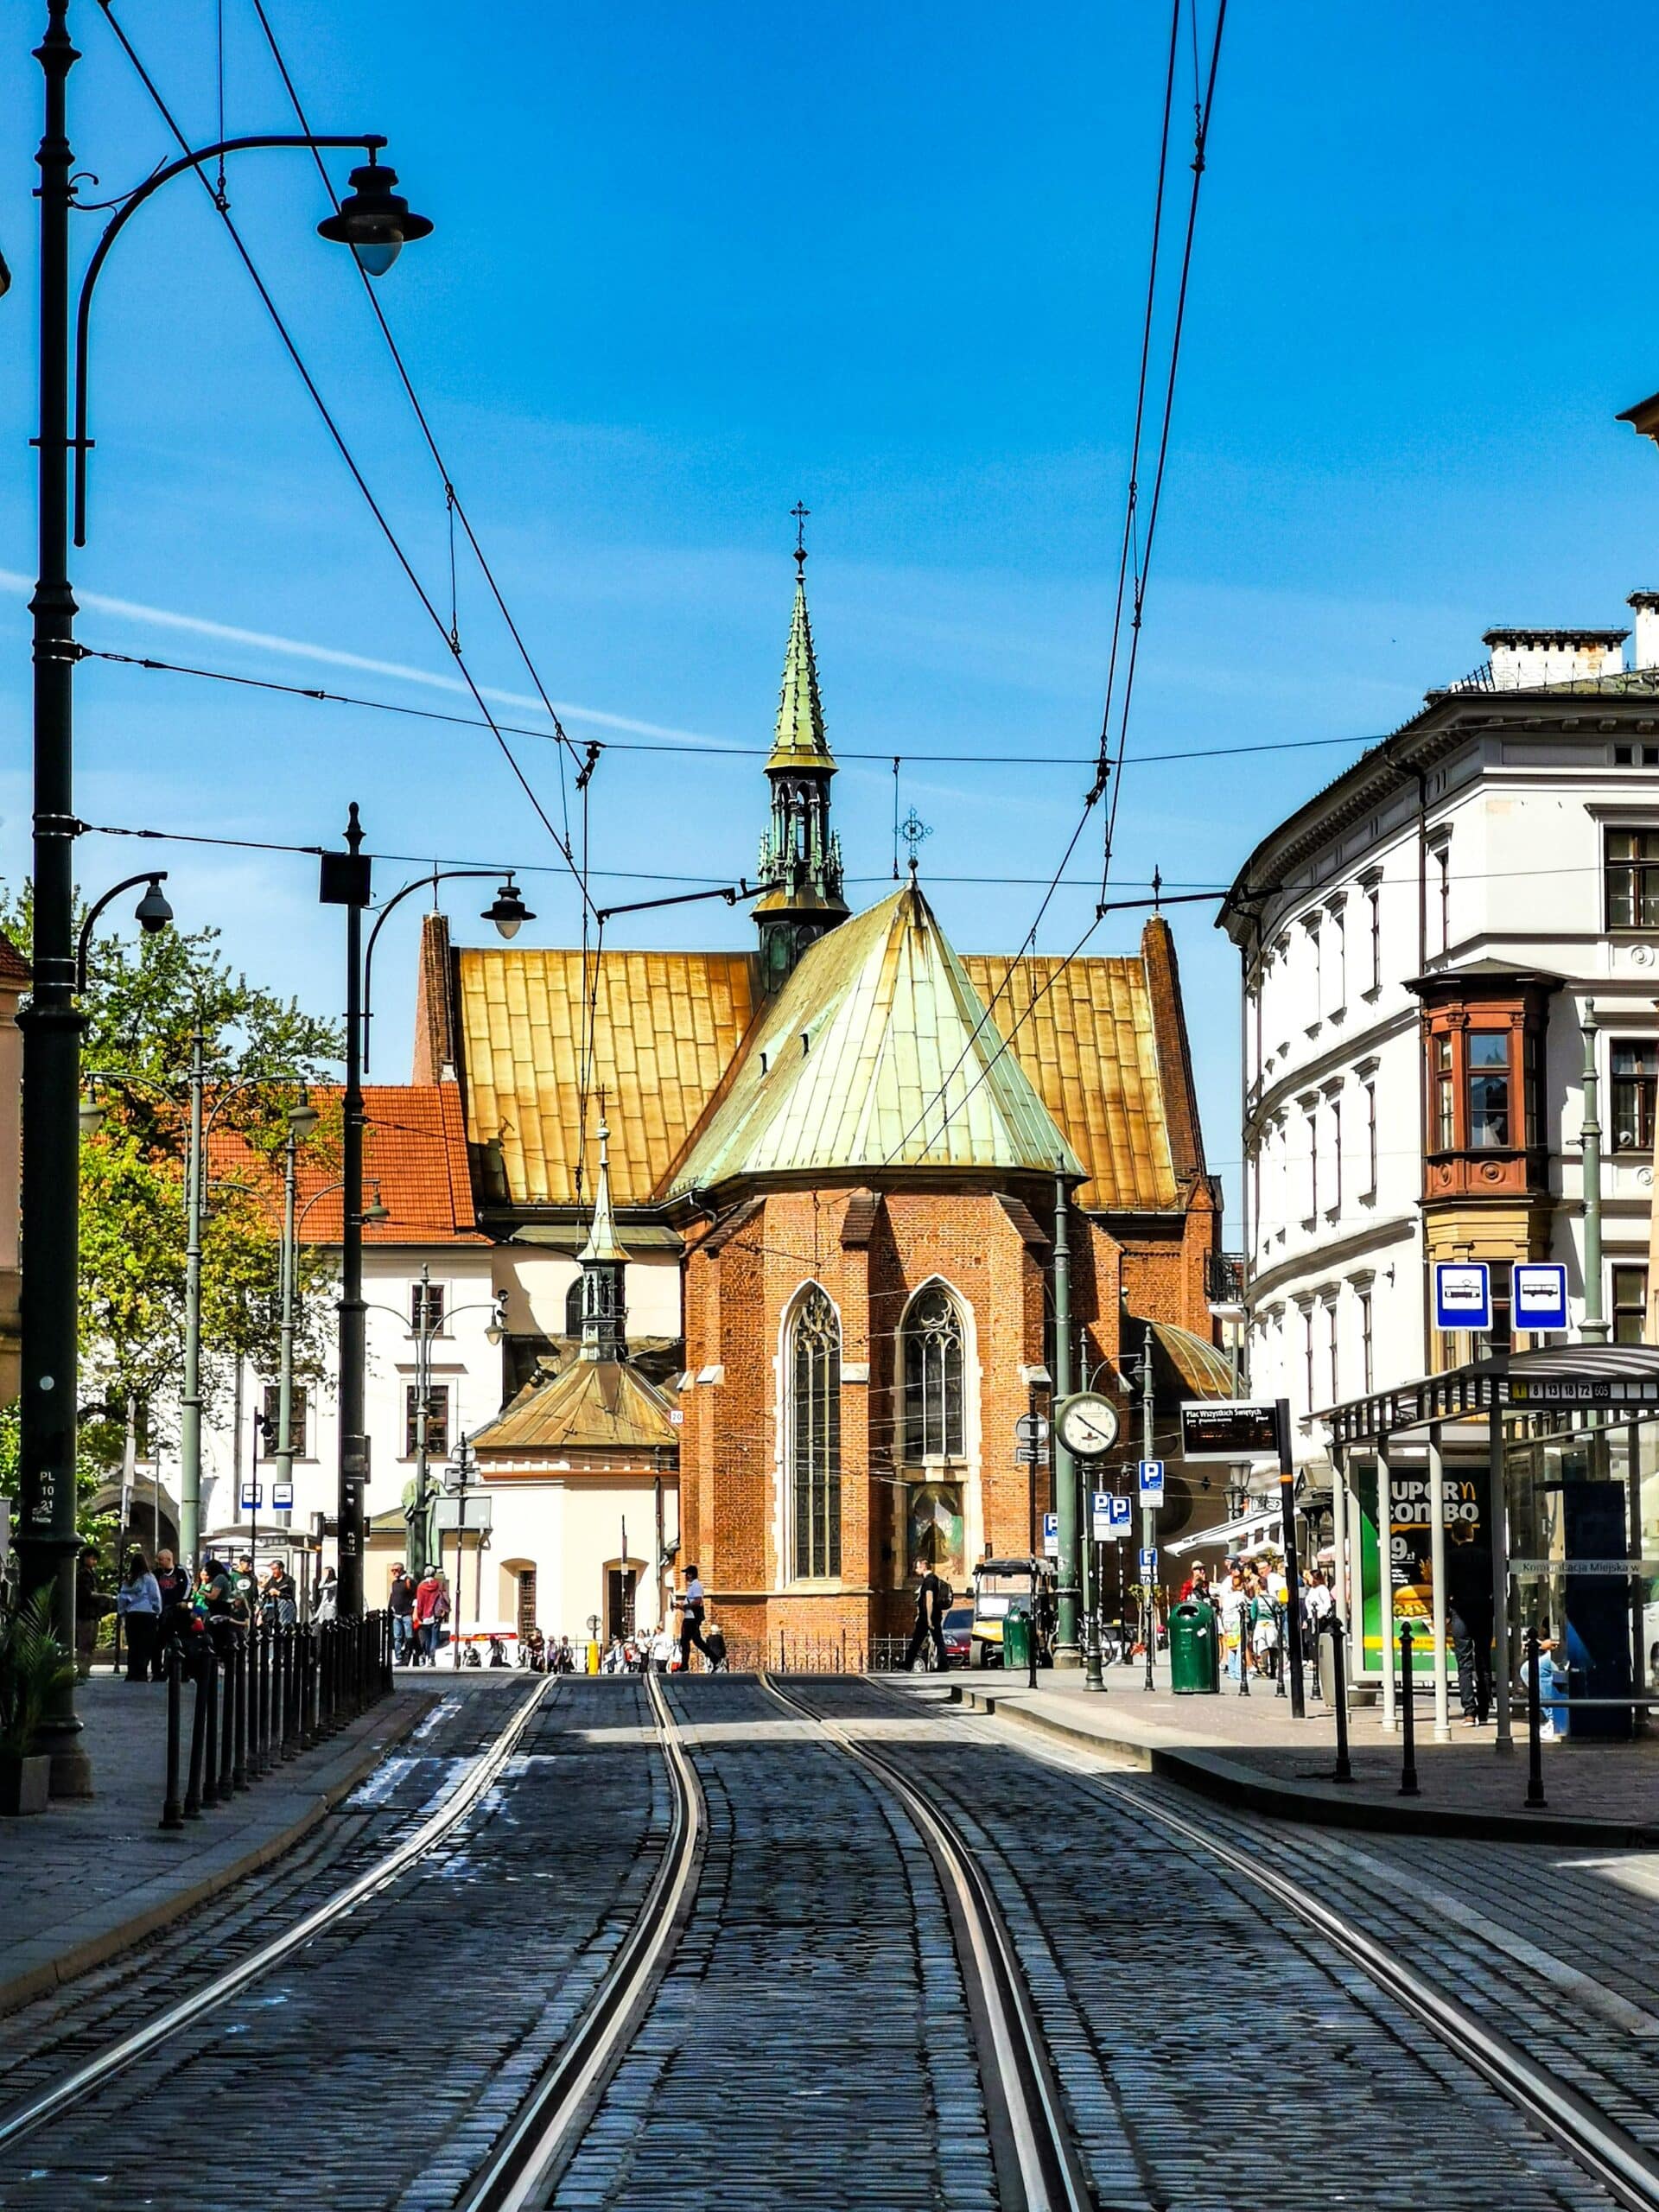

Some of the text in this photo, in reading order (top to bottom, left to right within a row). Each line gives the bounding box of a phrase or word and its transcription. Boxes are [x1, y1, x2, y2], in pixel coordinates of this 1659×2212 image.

[1533, 1383, 1539, 1396] 8
[1548, 1383, 1558, 1396] 13
[1580, 1383, 1591, 1396] 72
[40, 1471, 56, 1482] PL
[42, 1485, 54, 1496] 10
